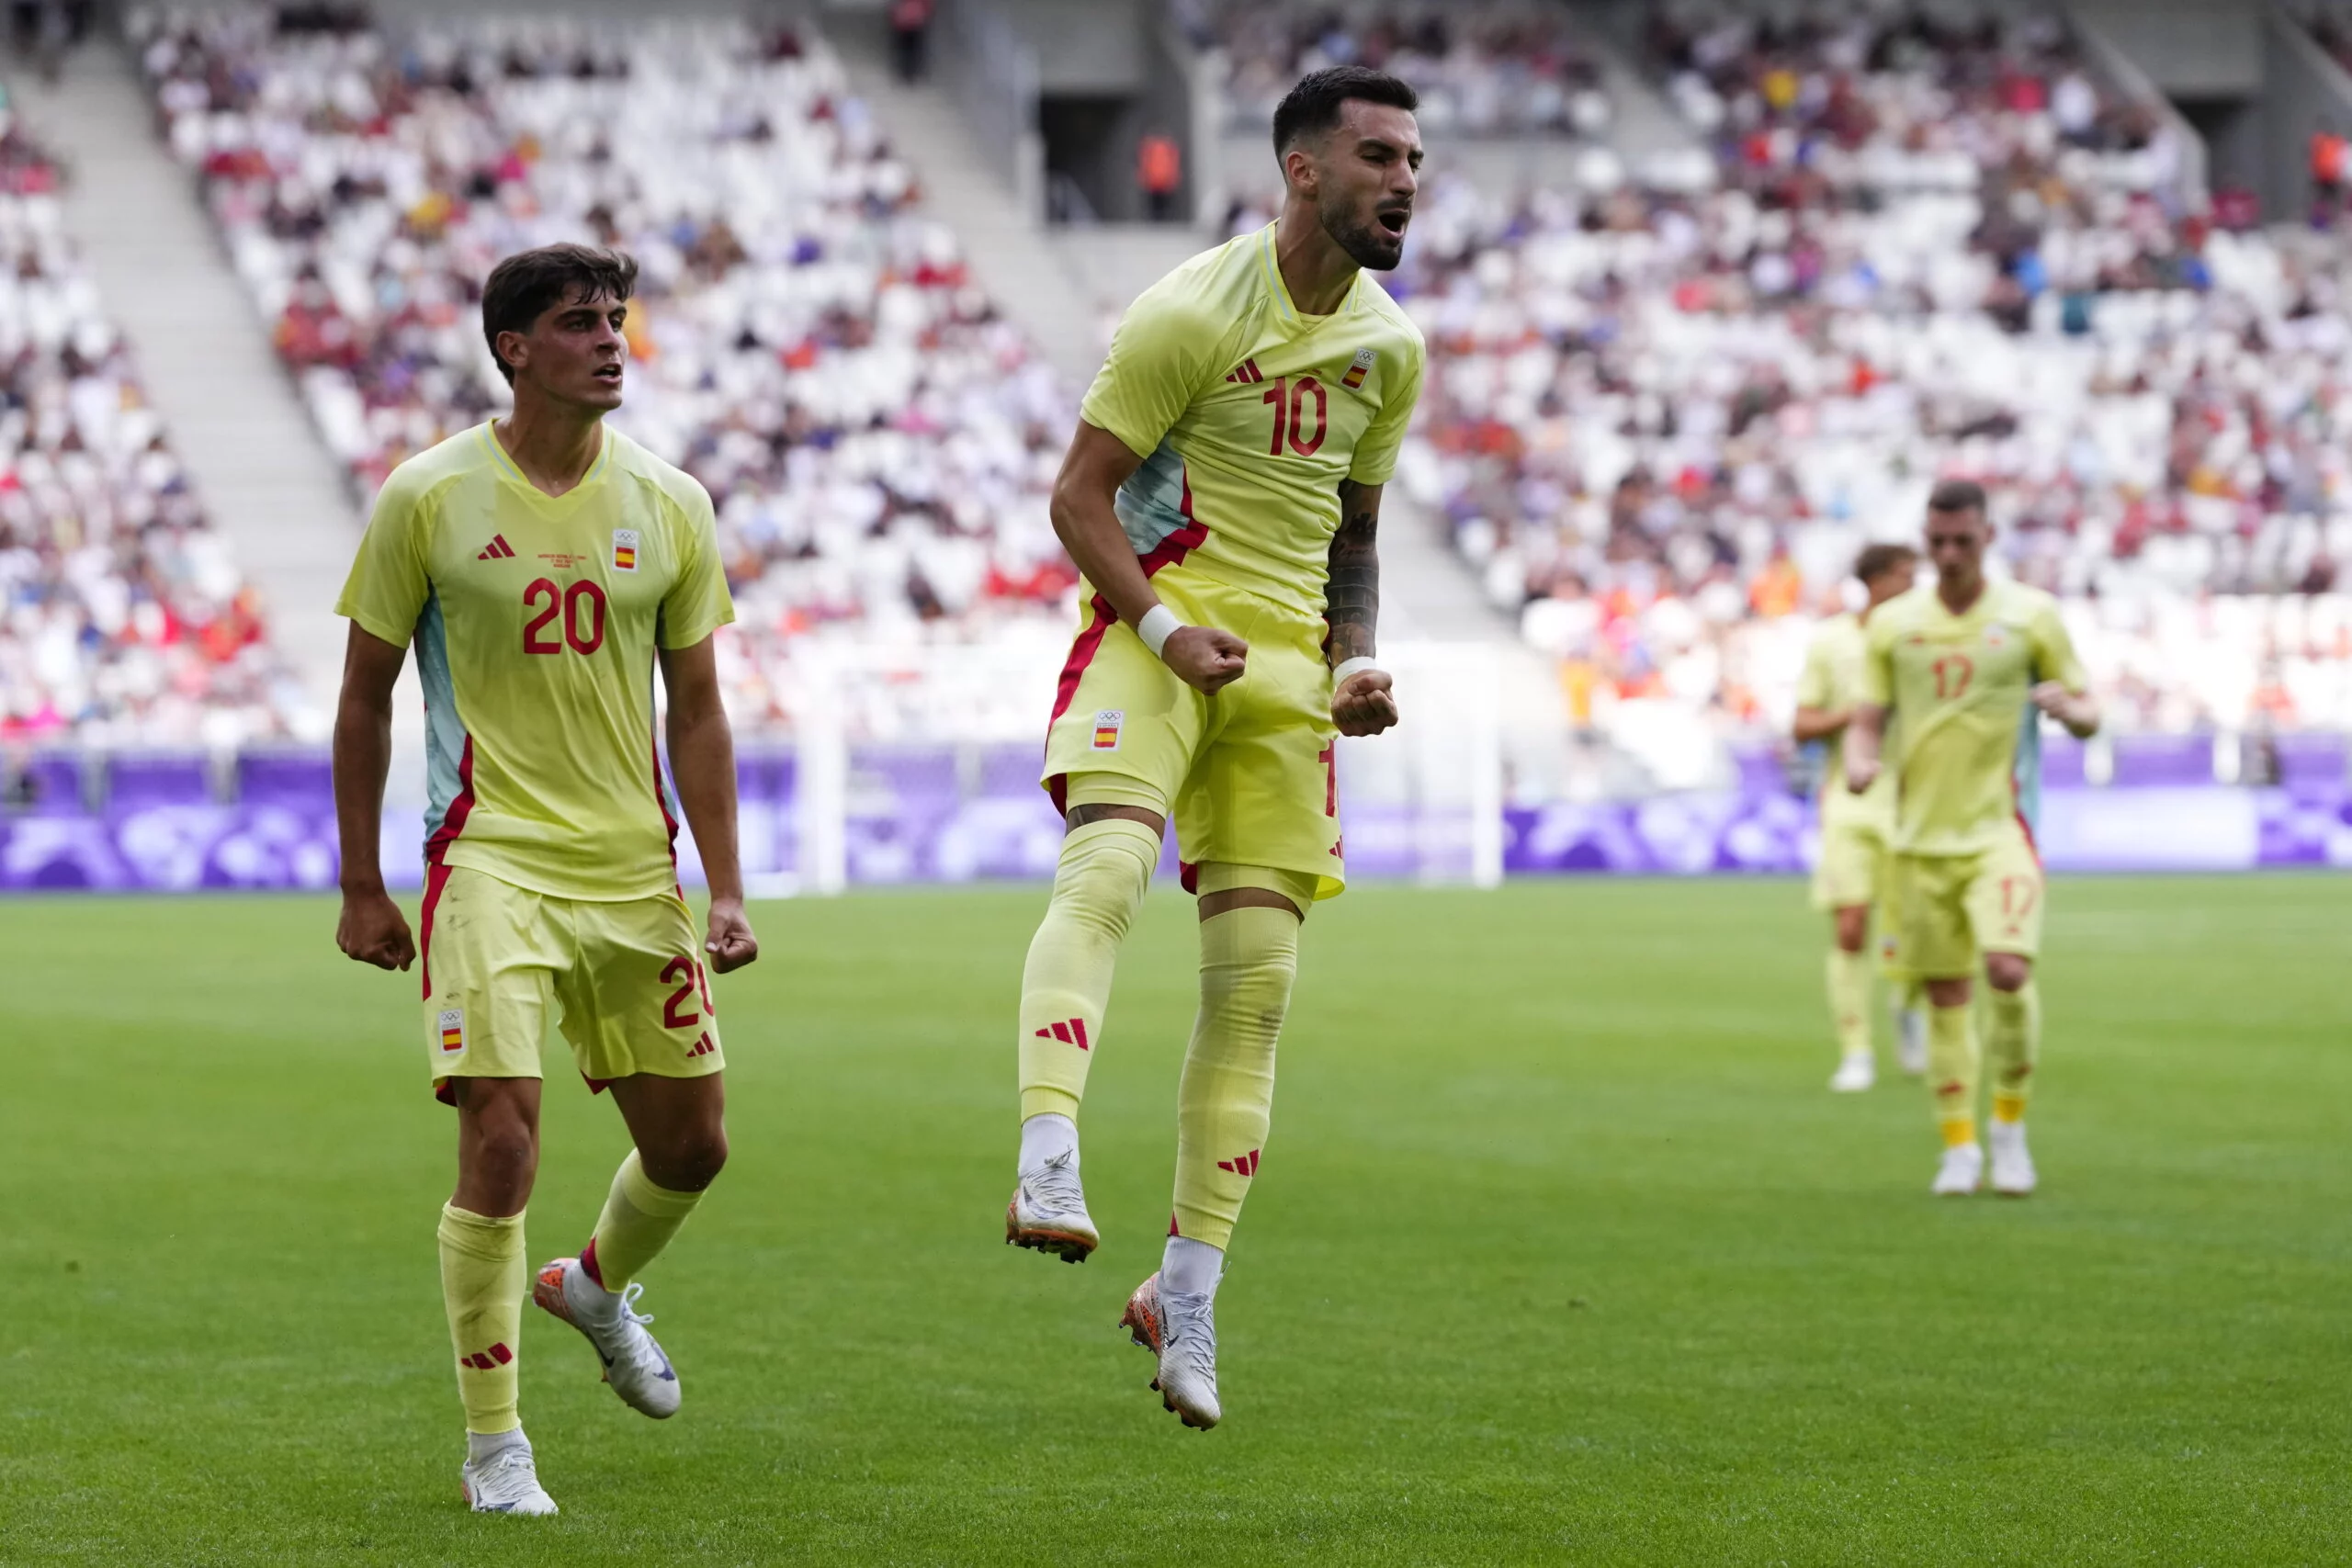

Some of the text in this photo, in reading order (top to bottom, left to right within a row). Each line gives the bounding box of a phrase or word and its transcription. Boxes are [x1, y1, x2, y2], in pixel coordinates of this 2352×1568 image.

[1263, 377, 1327, 457] 10
[524, 577, 605, 655] 20
[1929, 654, 1974, 699] 17
